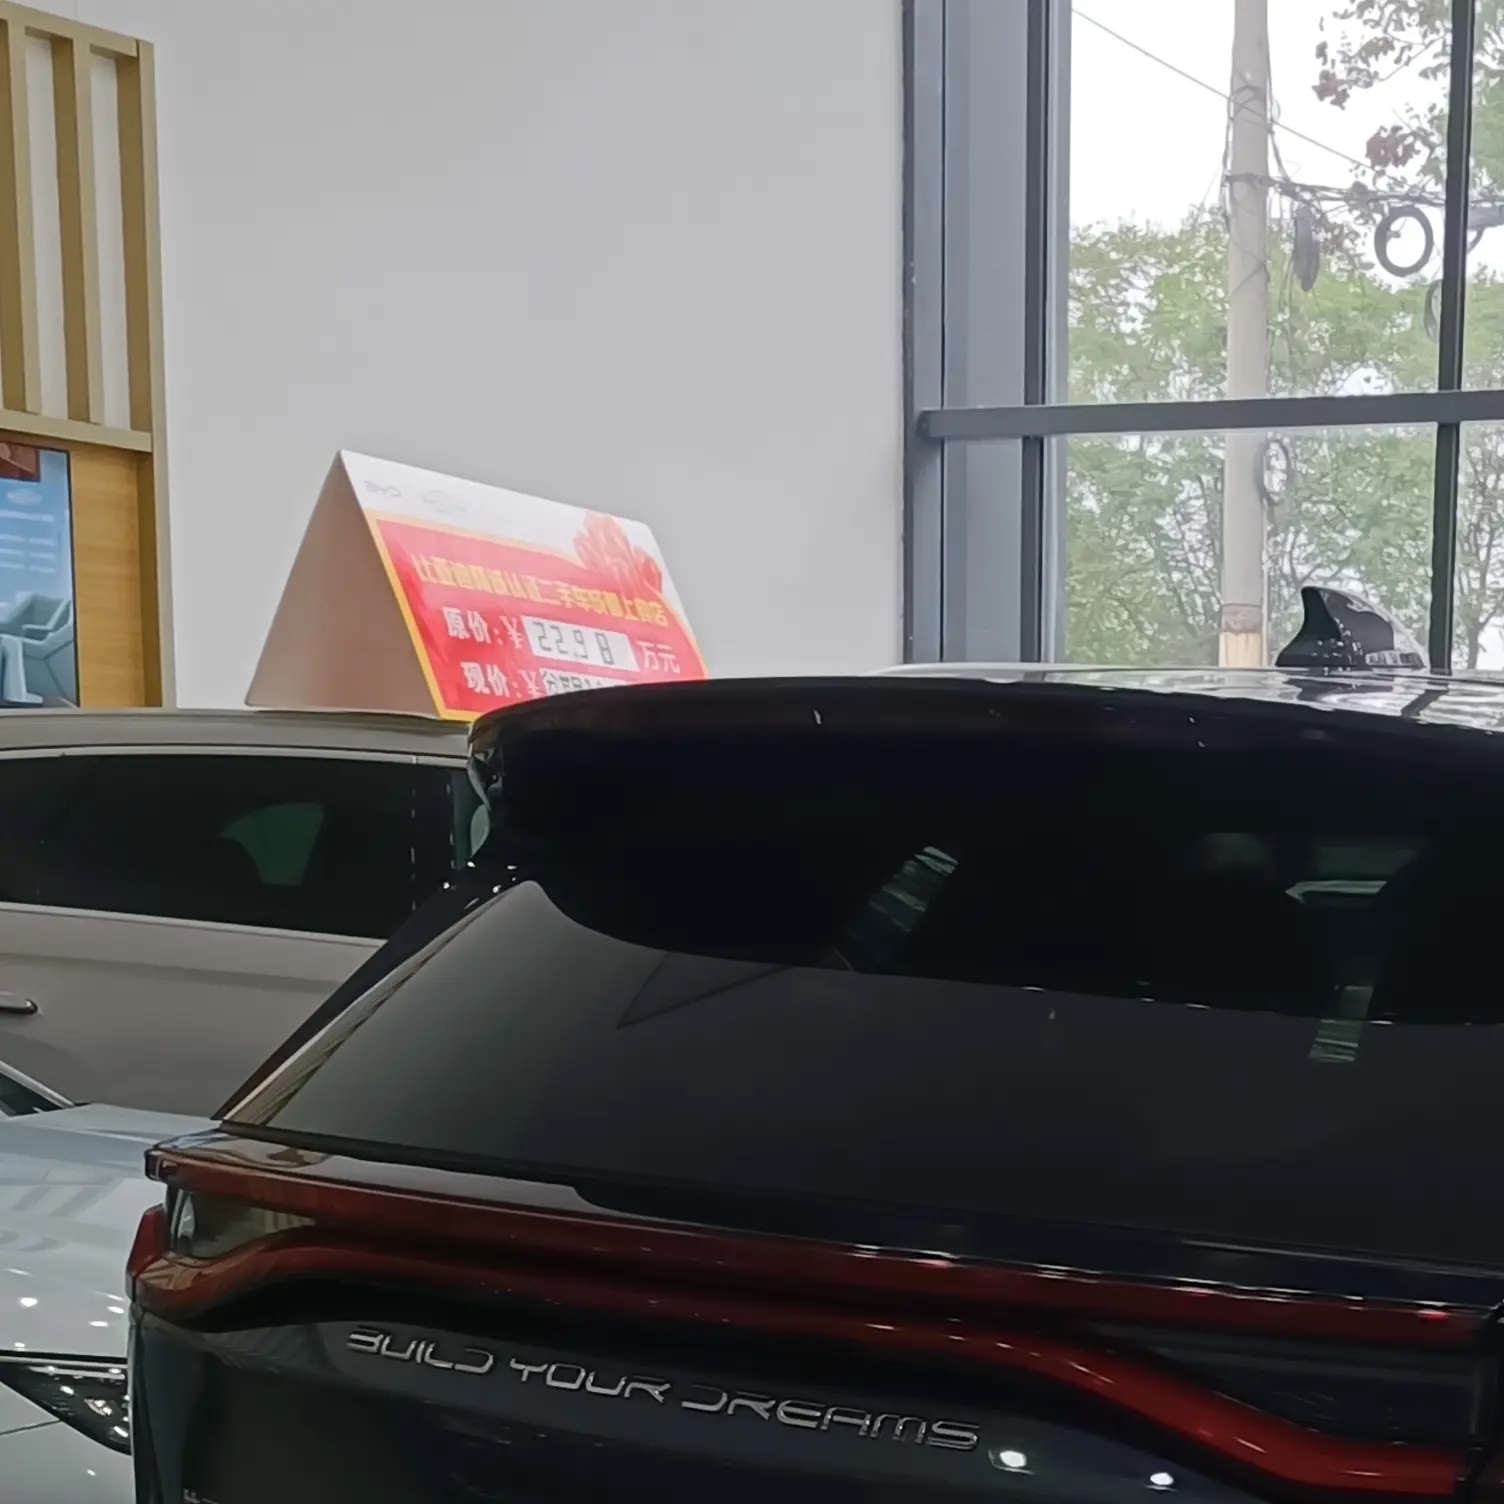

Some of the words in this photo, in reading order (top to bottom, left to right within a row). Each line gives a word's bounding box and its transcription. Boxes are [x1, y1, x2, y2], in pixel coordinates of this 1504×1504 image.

[347, 1327, 495, 1374] BUILD
[510, 1358, 671, 1403] YOUR
[682, 1385, 981, 1451] DREAMS
